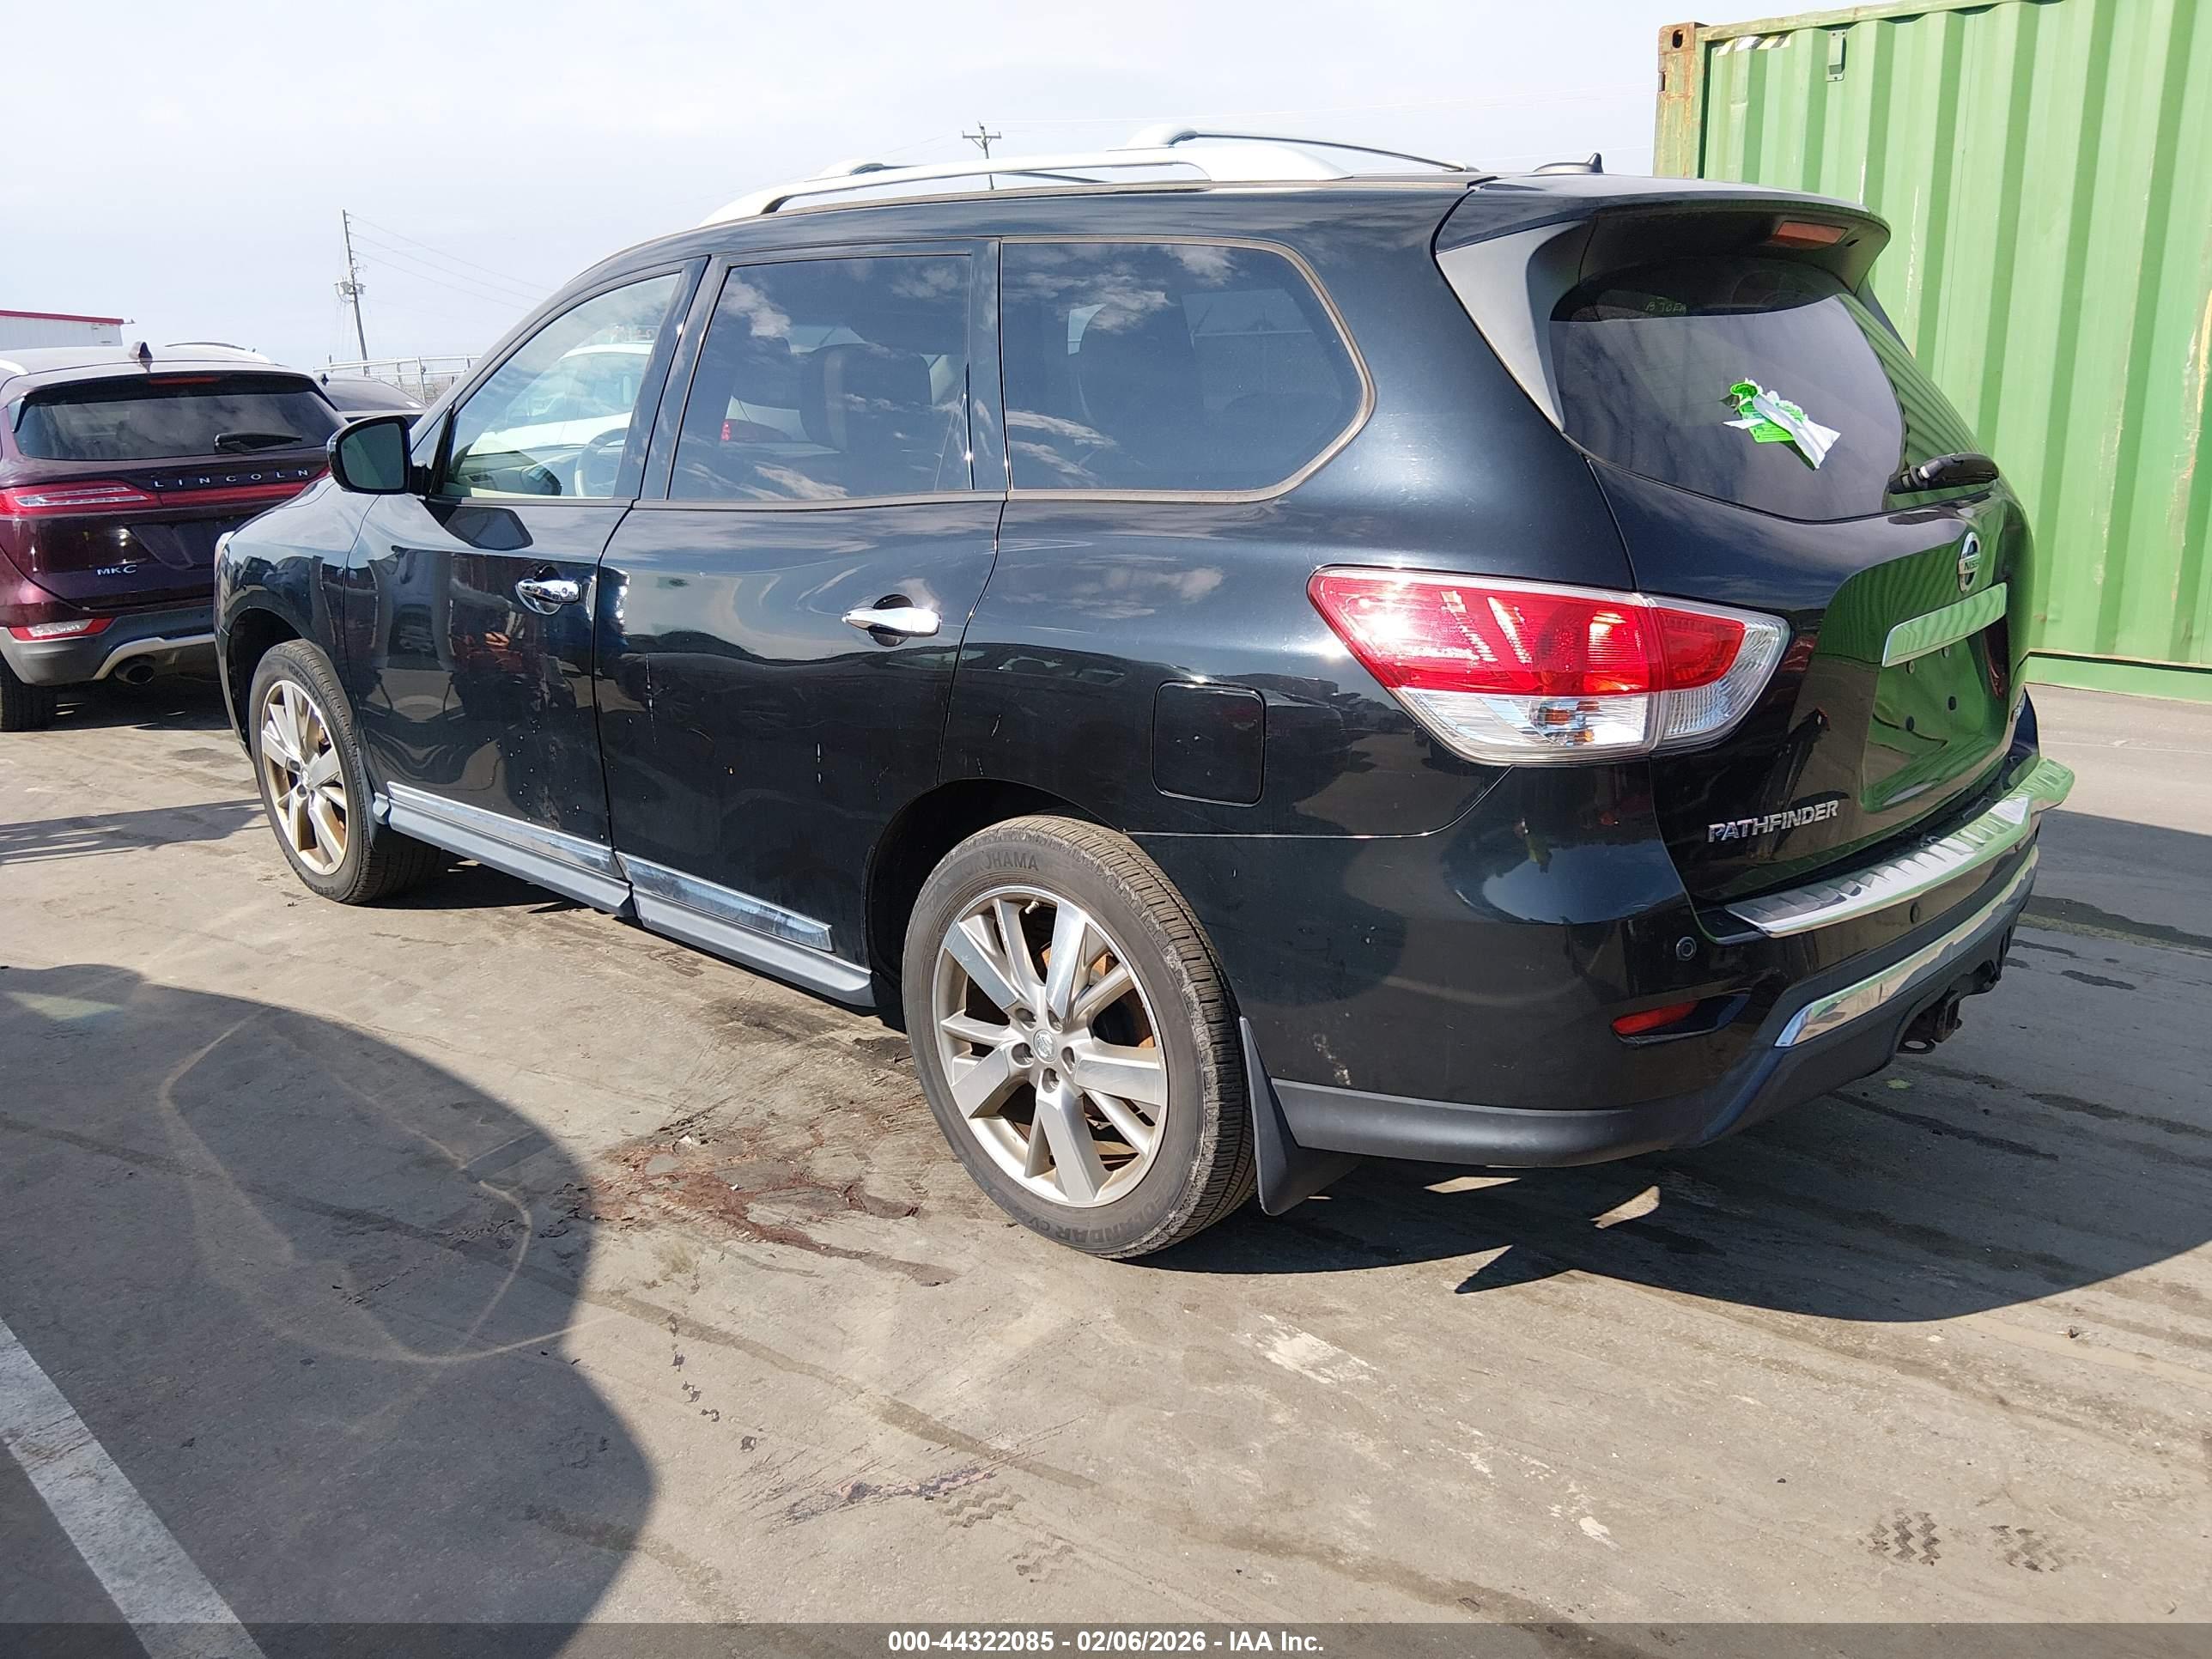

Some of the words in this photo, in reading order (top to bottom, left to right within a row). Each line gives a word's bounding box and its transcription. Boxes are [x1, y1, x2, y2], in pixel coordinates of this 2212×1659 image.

[154, 469, 308, 488] LINCOLN
[96, 564, 137, 575] MKC
[1707, 799, 1839, 843] PATHFINDER
[956, 850, 1040, 877] OKOHAMA
